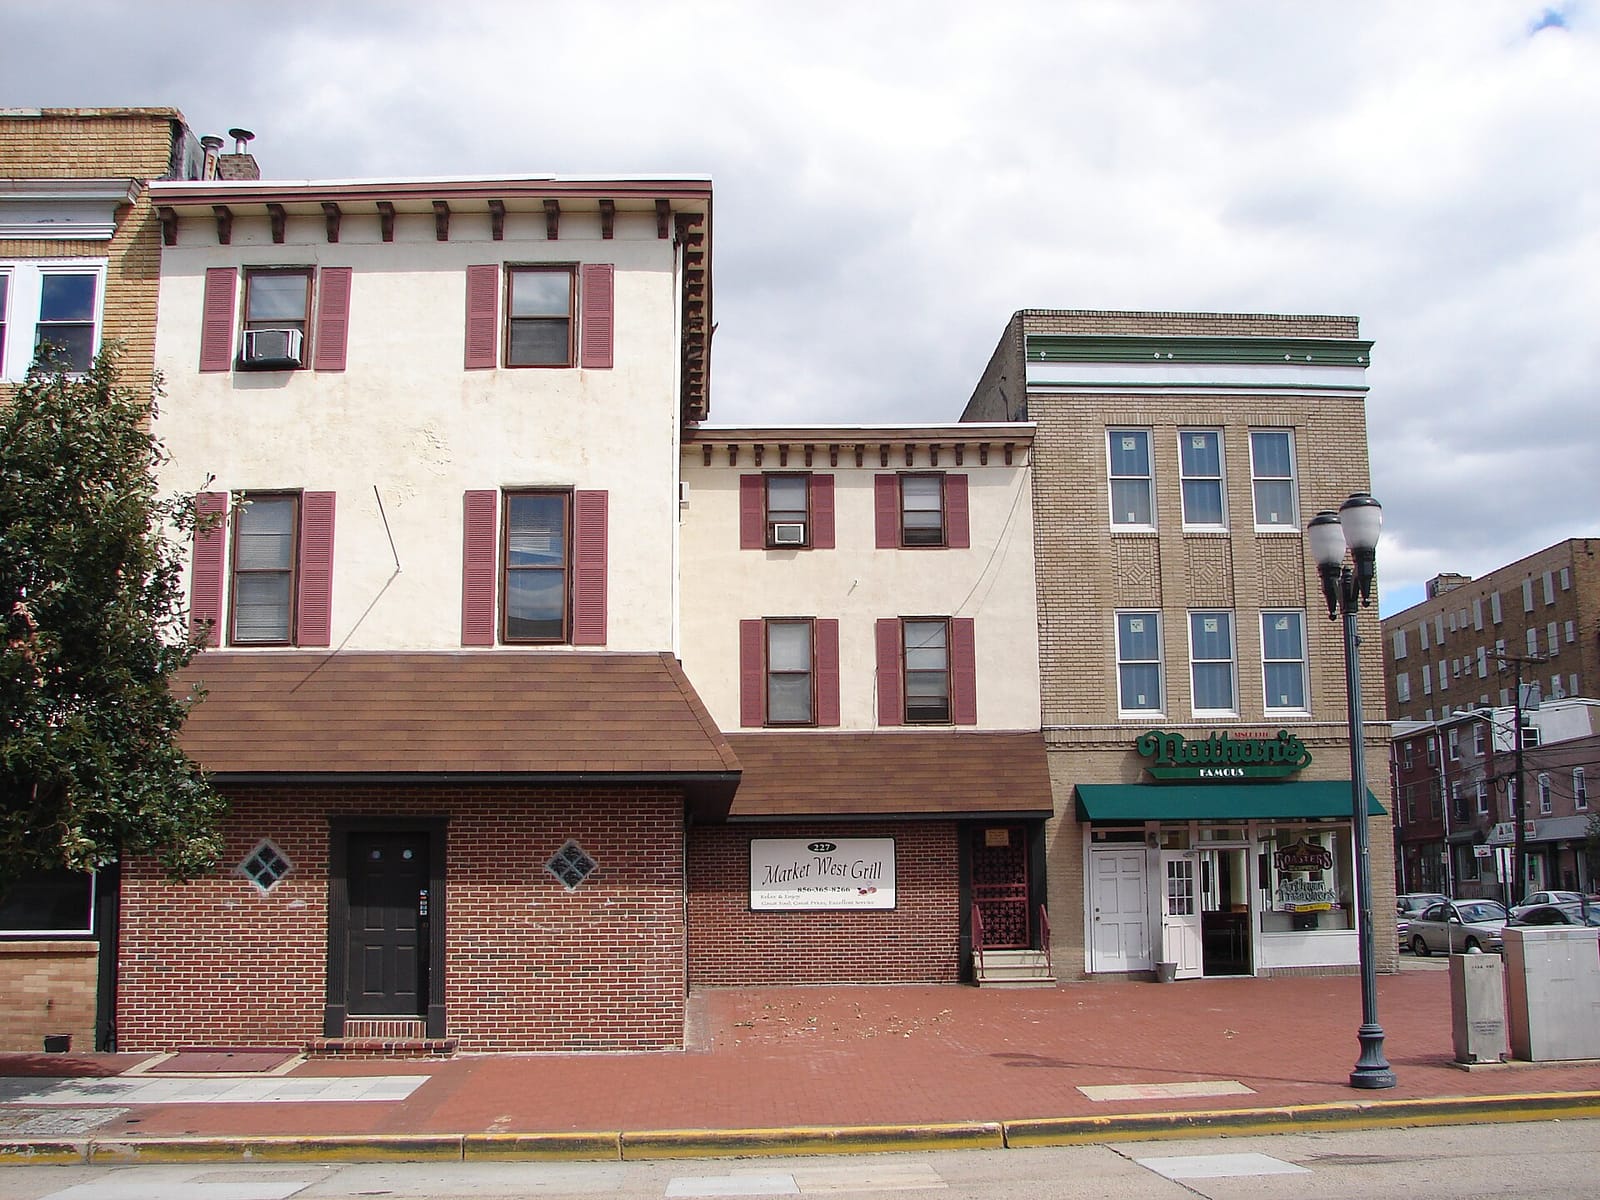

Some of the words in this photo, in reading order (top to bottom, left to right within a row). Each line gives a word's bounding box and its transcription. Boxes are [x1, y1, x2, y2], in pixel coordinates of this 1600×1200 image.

[1136, 730, 1312, 769] Nathan's
[1199, 768, 1245, 777] FAMOUS
[813, 843, 831, 851] 227
[761, 861, 811, 886] Market
[813, 856, 848, 877] West
[851, 860, 882, 880] Grill
[1274, 850, 1332, 871] ROASTERS
